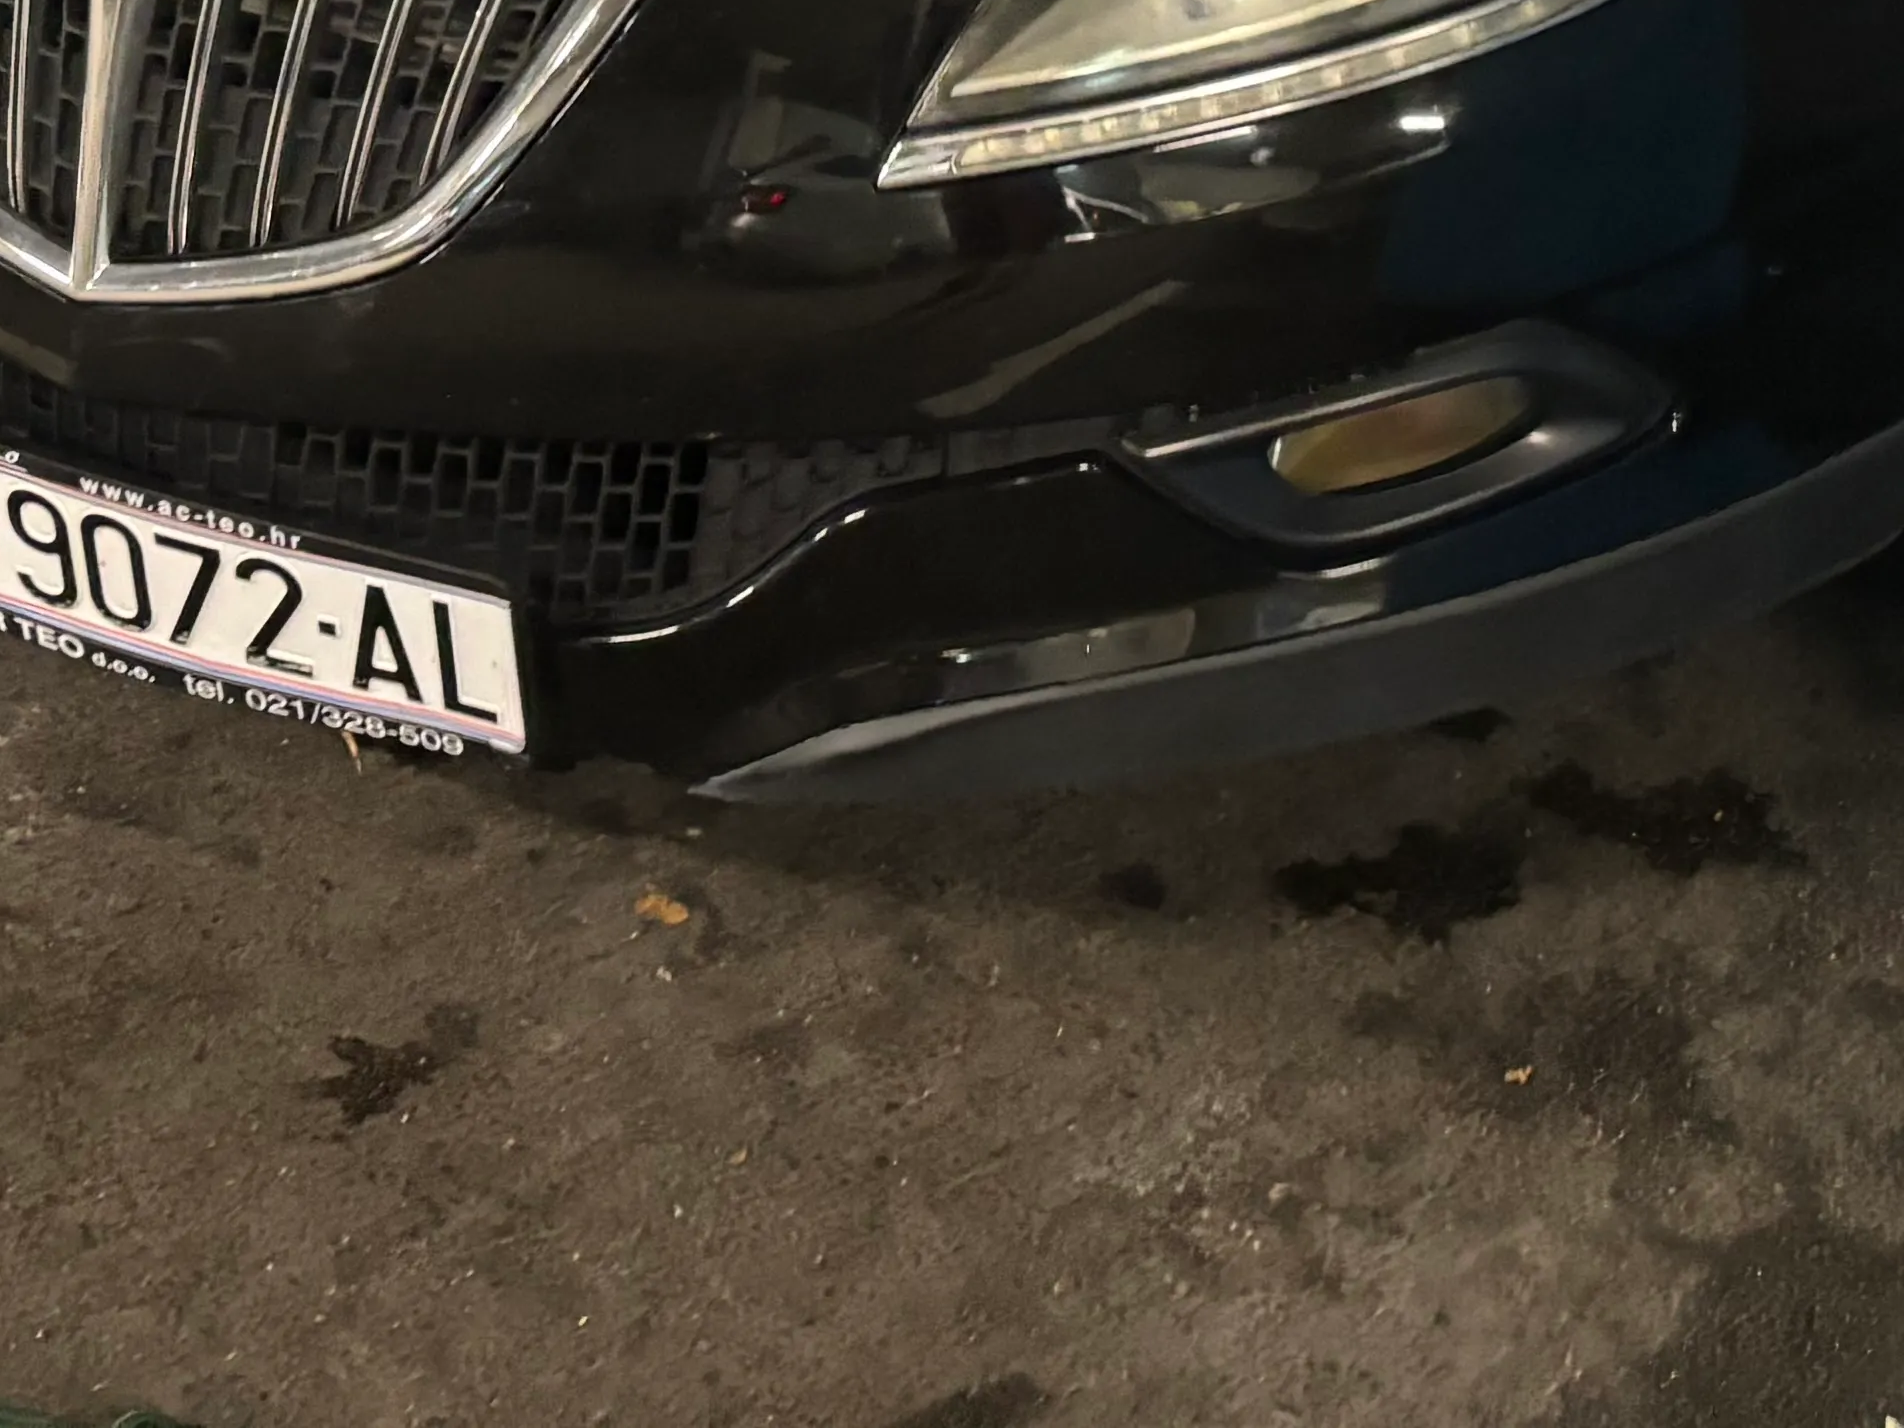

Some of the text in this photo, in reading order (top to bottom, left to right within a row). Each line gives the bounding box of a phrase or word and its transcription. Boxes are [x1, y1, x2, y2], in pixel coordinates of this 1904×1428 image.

[79, 475, 301, 550] www.ac-teo.hr
[7, 488, 498, 725] 9072-AL
[13, 616, 85, 659] TEO
[90, 651, 156, 684] d.o.o.
[182, 672, 234, 705] tel.
[245, 687, 465, 756] 021/328-509
